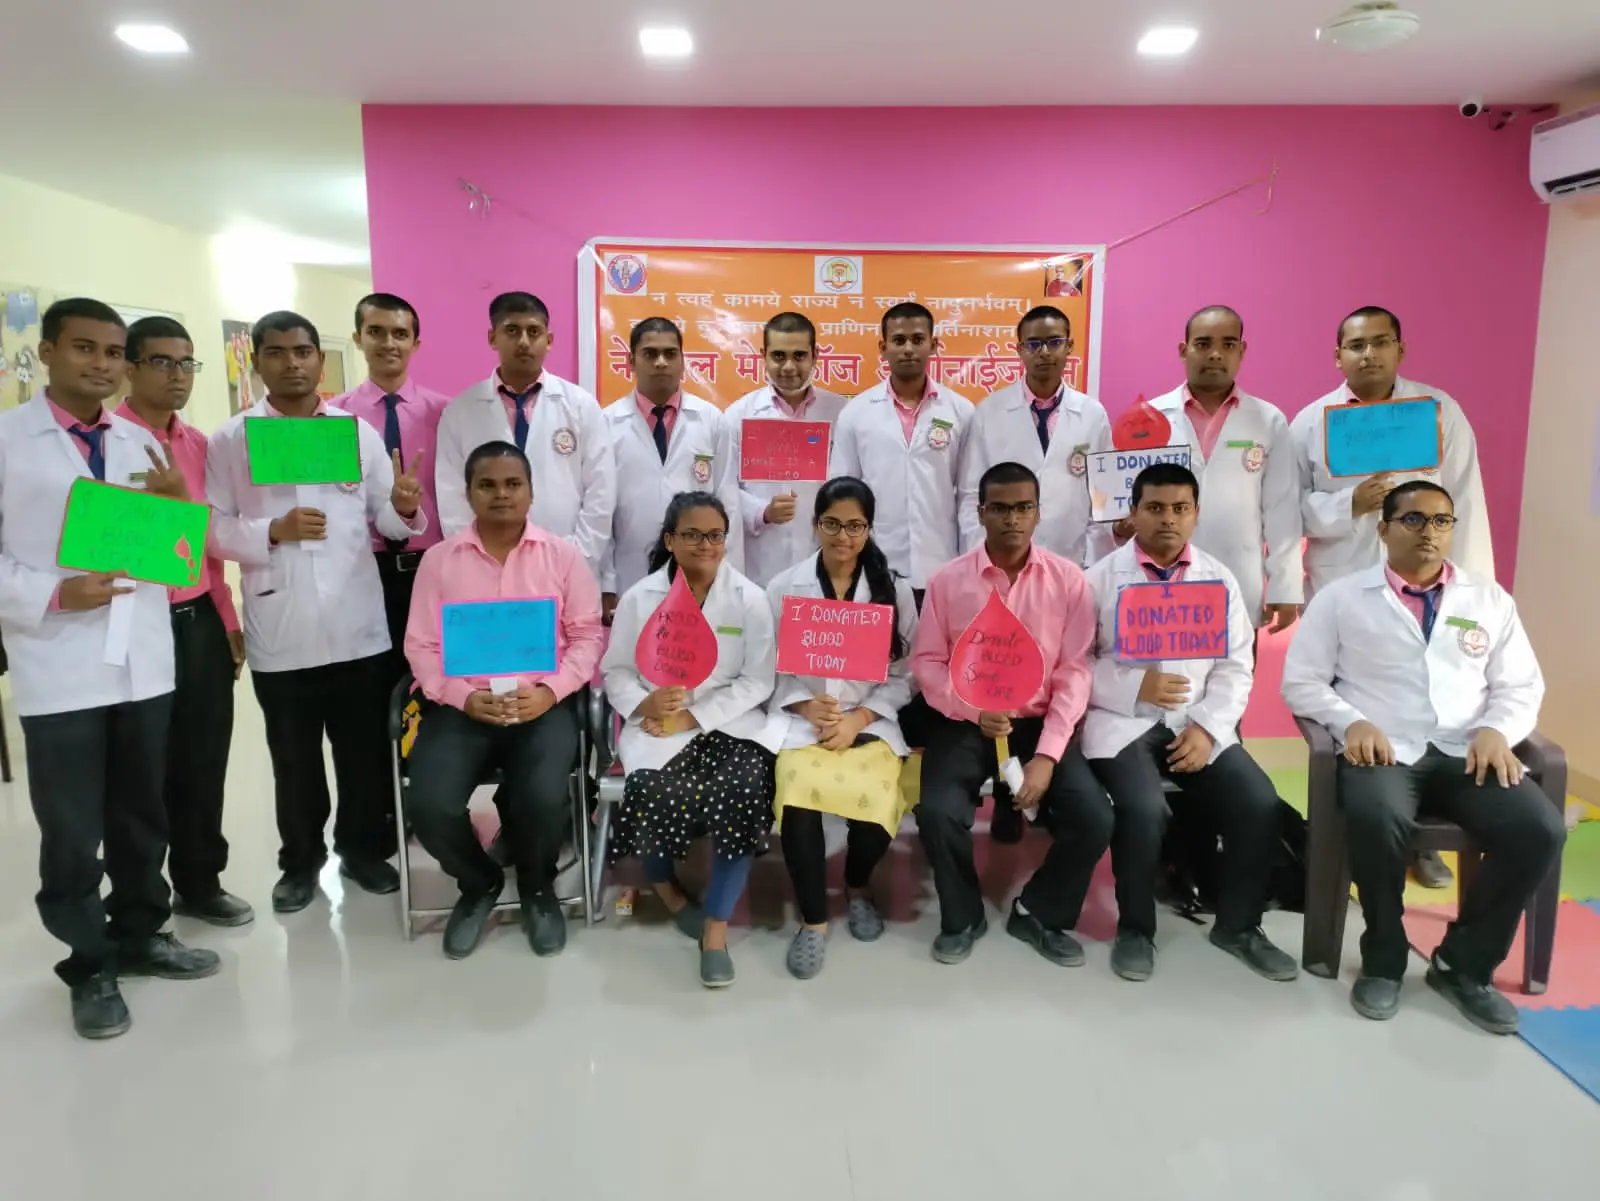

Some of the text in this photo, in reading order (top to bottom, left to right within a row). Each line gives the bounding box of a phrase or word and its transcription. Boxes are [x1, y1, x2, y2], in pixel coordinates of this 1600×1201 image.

[723, 288, 782, 309] कामये
[1096, 457, 1107, 473] I
[1160, 583, 1175, 599] I
[792, 602, 881, 626] I DONATED
[1126, 604, 1214, 628] DONATED
[801, 629, 844, 648] BLOOD
[1168, 630, 1225, 653] TODAY
[805, 653, 846, 673] TODAY
